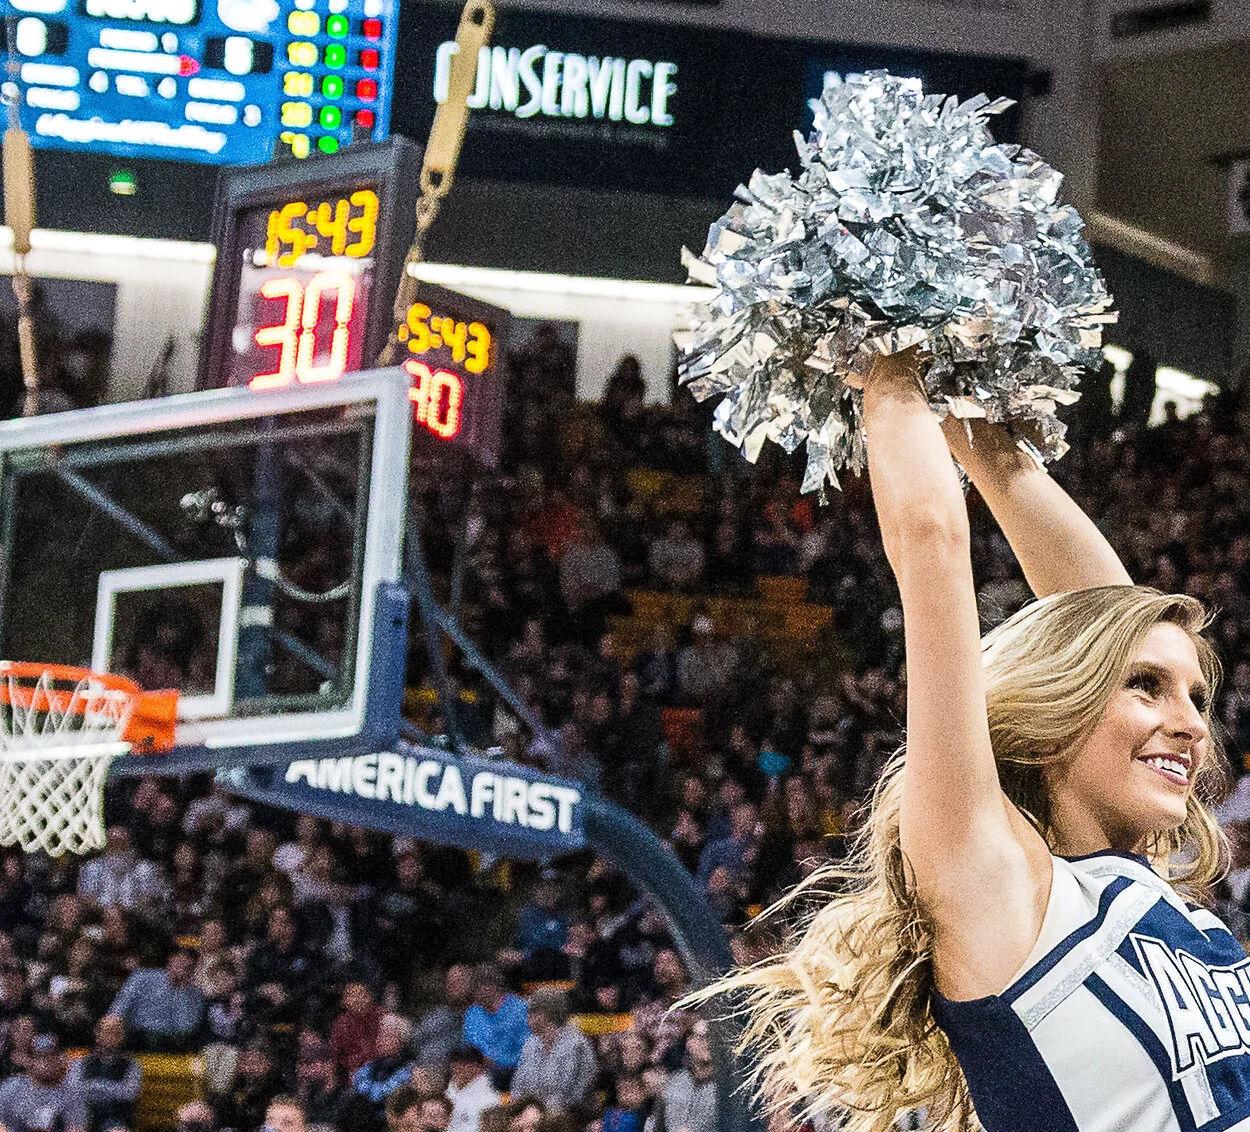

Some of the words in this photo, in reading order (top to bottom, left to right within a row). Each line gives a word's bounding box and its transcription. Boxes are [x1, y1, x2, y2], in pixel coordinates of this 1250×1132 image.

[265, 190, 379, 266] 15:43
[248, 273, 357, 391] 30
[470, 772, 581, 833] FIRST
